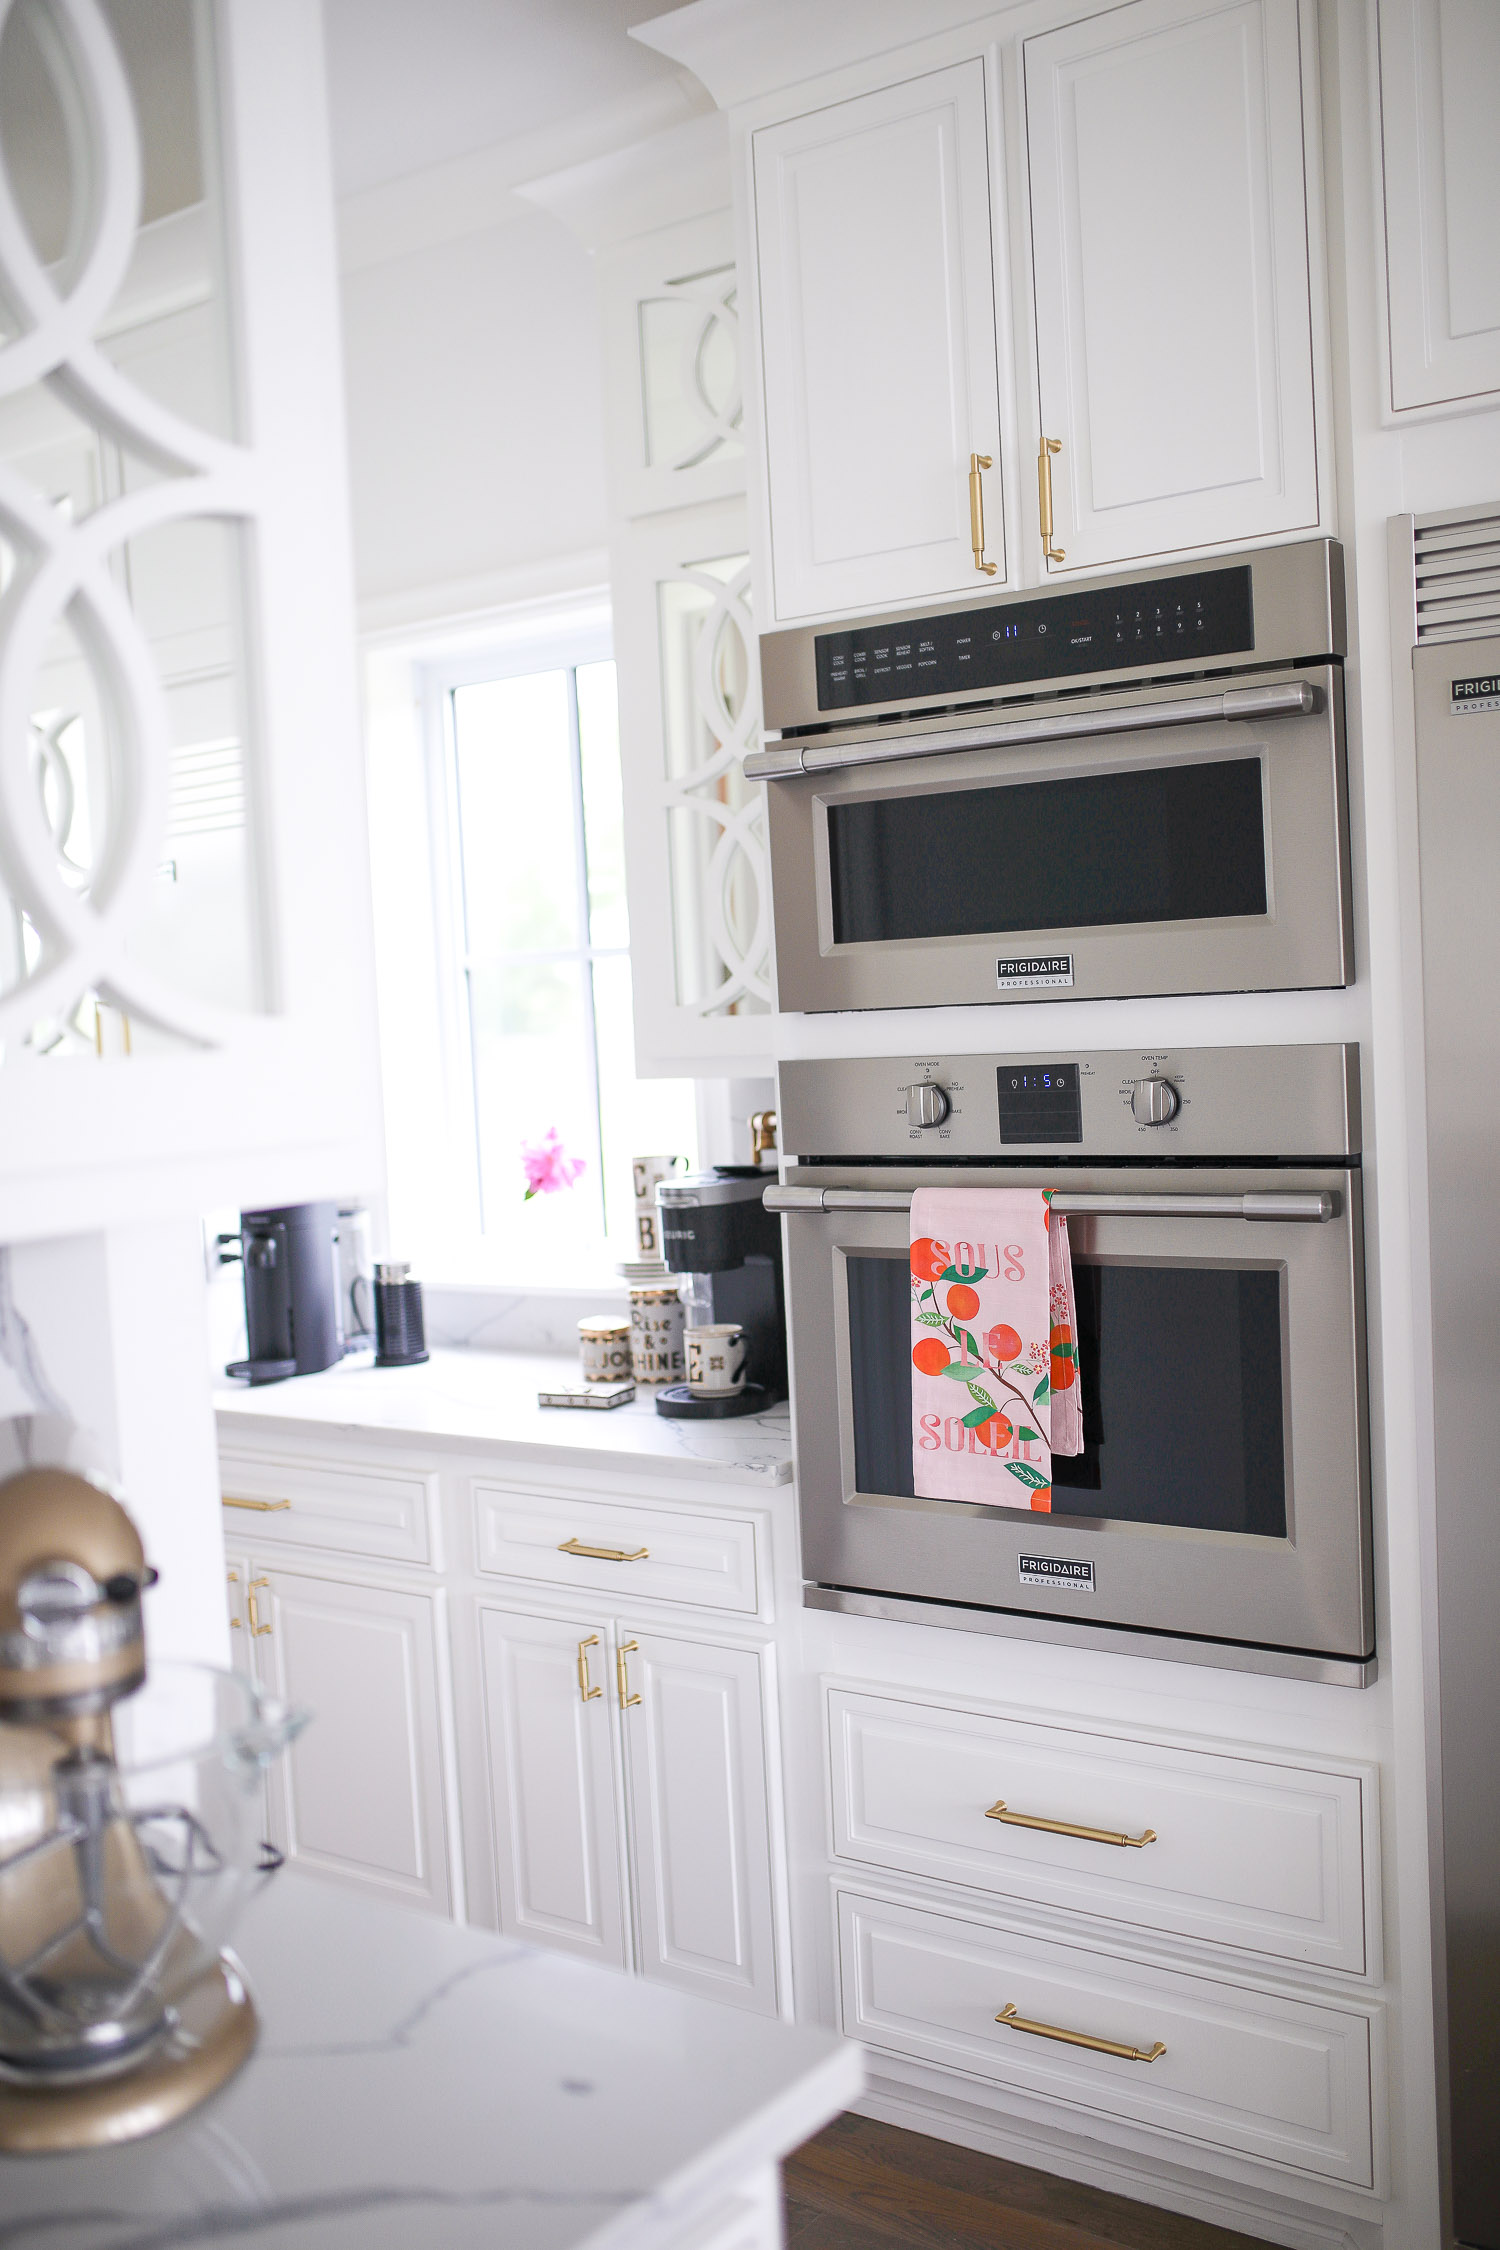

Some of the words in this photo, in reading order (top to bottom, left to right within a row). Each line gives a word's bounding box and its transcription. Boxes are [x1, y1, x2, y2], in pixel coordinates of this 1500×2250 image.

[1071, 635, 1092, 644] OK/START
[1456, 701, 1500, 711] PROFES
[1000, 960, 1068, 973] FRIGIDAIRE
[1001, 978, 1068, 986] PROFESSIONAL
[638, 1216, 655, 1251] B
[663, 1229, 695, 1240] EURIG
[930, 1239, 1026, 1282] SOUS
[644, 1335, 655, 1349] &
[959, 1330, 1003, 1369] LE
[635, 1352, 682, 1372] HINE
[919, 1413, 1042, 1463] SOLEIL
[1022, 1559, 1089, 1577] FRIGIDAIRE
[1023, 1576, 1089, 1589] PROFESSIONAL
